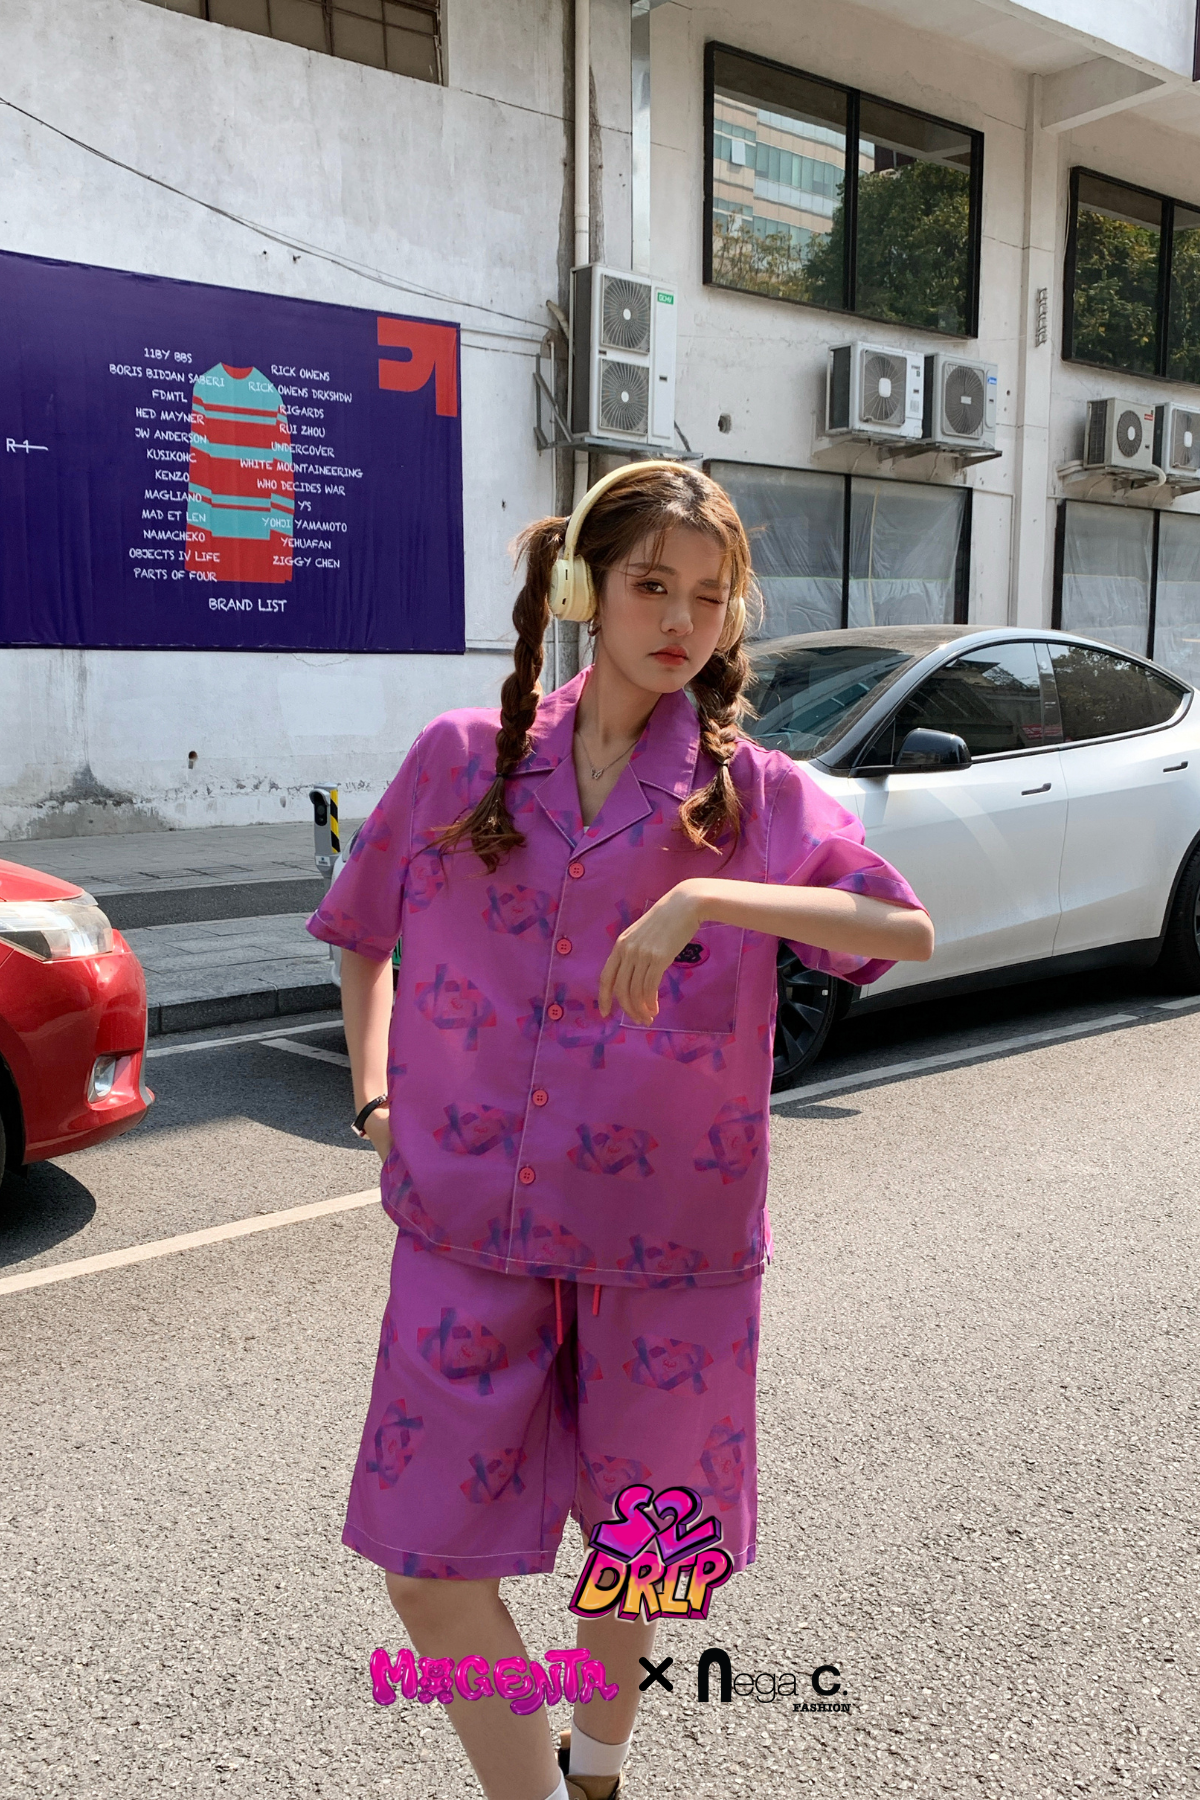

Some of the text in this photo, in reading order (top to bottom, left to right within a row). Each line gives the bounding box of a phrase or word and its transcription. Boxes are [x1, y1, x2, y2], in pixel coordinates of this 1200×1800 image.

[144, 348, 193, 364] 11BY BBS
[109, 364, 225, 387] BORIS BIDJAN SABERI
[271, 364, 330, 382] RICK OWENS
[152, 389, 188, 403] FDMTL
[248, 381, 352, 403] RICK OWENS DRKSHDW
[135, 407, 205, 425] HED MAYNER
[279, 404, 325, 419] RIGARDS
[135, 428, 207, 444] JW ANDERSON
[279, 423, 326, 438] RUI ZHOU
[147, 448, 197, 463] KUSIKOHC
[271, 441, 335, 458] UNDERCOVER
[155, 469, 190, 482] KENZO
[240, 458, 363, 478] WHITE MOUNTAINEERING
[256, 478, 346, 496] WHO DECIDES WAR
[144, 489, 202, 503] MAGLIANO
[141, 509, 207, 522] MAD ET LEN
[261, 517, 347, 533] YOHJI YAMAMOTO
[143, 529, 206, 542] NAMACHEKO
[280, 537, 332, 550] YEHUAFAN
[129, 548, 221, 562] OBJECTS IV LIFE
[272, 555, 340, 569] ZIGGY CHEN
[133, 568, 218, 583] PARTS OF FOUR
[208, 598, 287, 613] BRAND LIST
